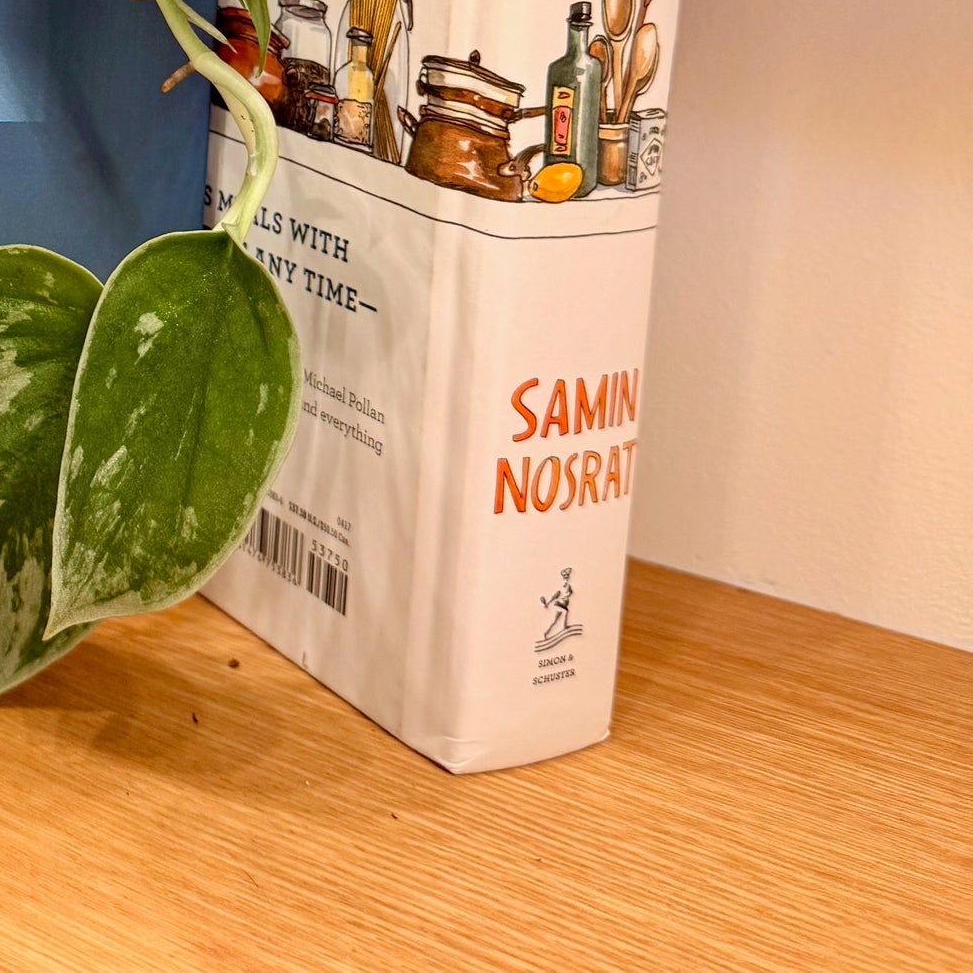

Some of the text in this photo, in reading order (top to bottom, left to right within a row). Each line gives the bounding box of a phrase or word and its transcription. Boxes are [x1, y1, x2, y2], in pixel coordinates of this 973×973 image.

[217, 190, 283, 235] MLS
[289, 217, 349, 263] WITH
[255, 247, 297, 285] ANY
[304, 368, 385, 425] Michael Pollan
[511, 368, 639, 443] SAMIN
[302, 401, 383, 457] nd everything
[493, 438, 638, 515] NOSRAT
[311, 539, 349, 572] 53750
[532, 668, 576, 685] SCHUSTER
[537, 653, 575, 669] SIMON &
